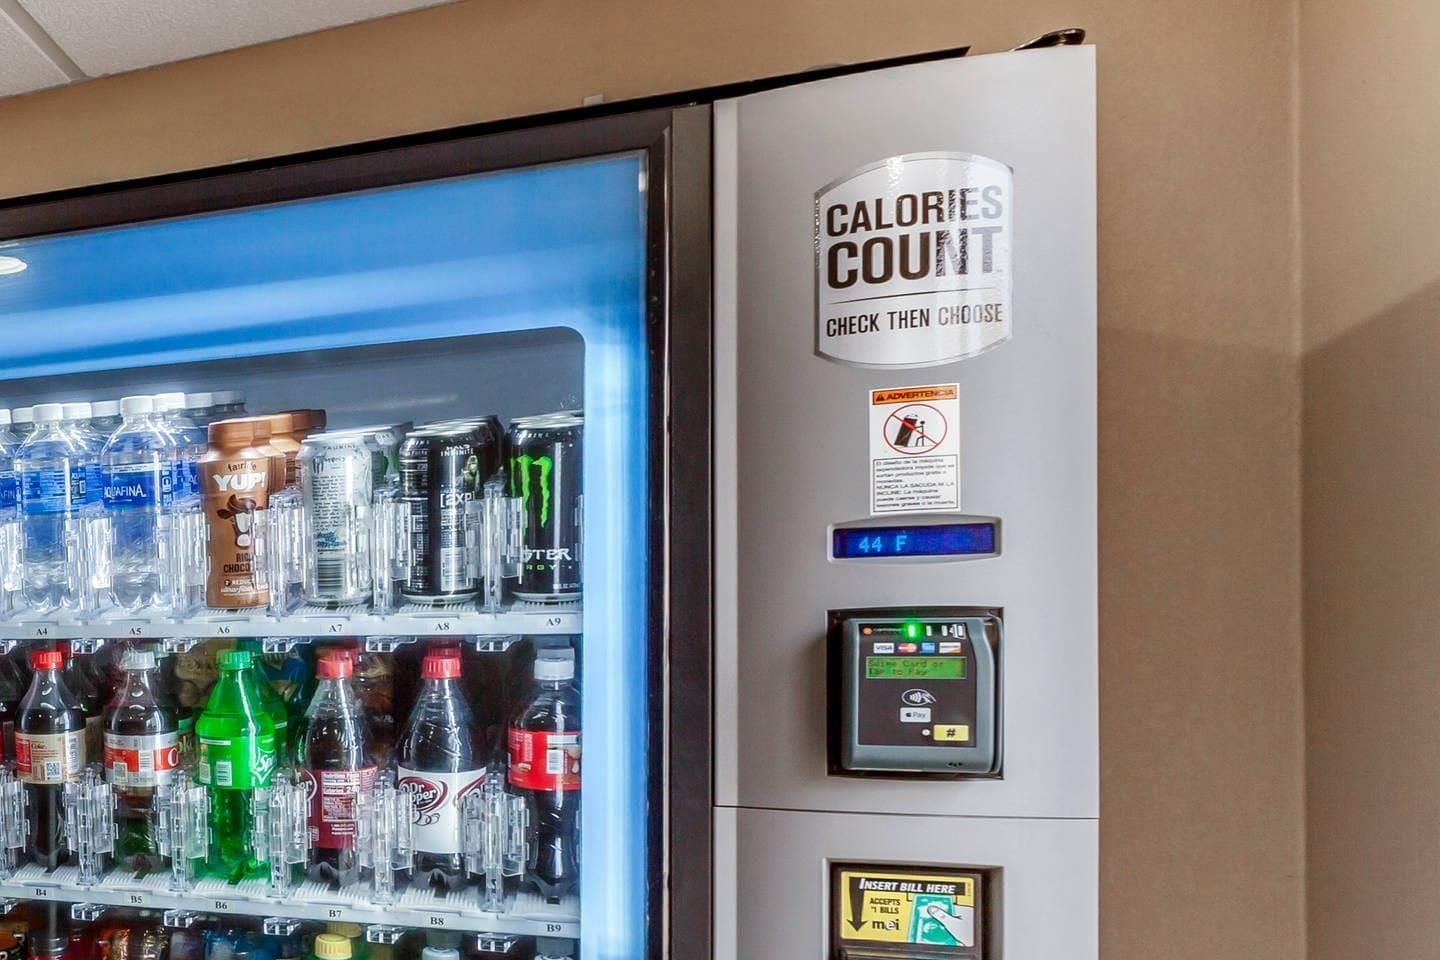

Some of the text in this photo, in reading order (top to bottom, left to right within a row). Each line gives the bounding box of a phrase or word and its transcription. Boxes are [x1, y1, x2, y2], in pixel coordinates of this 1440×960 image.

[826, 185, 1003, 237] CALORIES
[827, 226, 1003, 289] COUNT
[826, 303, 1003, 338] CHECK THEN CHOOSE
[887, 388, 954, 400] ADVERTENCIA
[212, 472, 267, 492] YUP!
[859, 535, 907, 552] 44 F
[435, 622, 450, 631] A8
[546, 618, 562, 626] A9
[36, 628, 48, 636] A4
[129, 627, 142, 636] A5
[216, 626, 230, 634] A6
[328, 624, 343, 633] A7
[410, 782, 424, 794] Dr
[859, 878, 956, 894] INSERT BILL HERE
[36, 888, 47, 896] B4
[130, 896, 142, 904] B5
[870, 898, 901, 906] ACCEPTS
[215, 902, 228, 910] B6
[880, 906, 899, 914] BILLS
[328, 910, 342, 918] B7
[430, 917, 444, 926] B8
[872, 919, 900, 930] mei
[546, 924, 561, 932] B9
